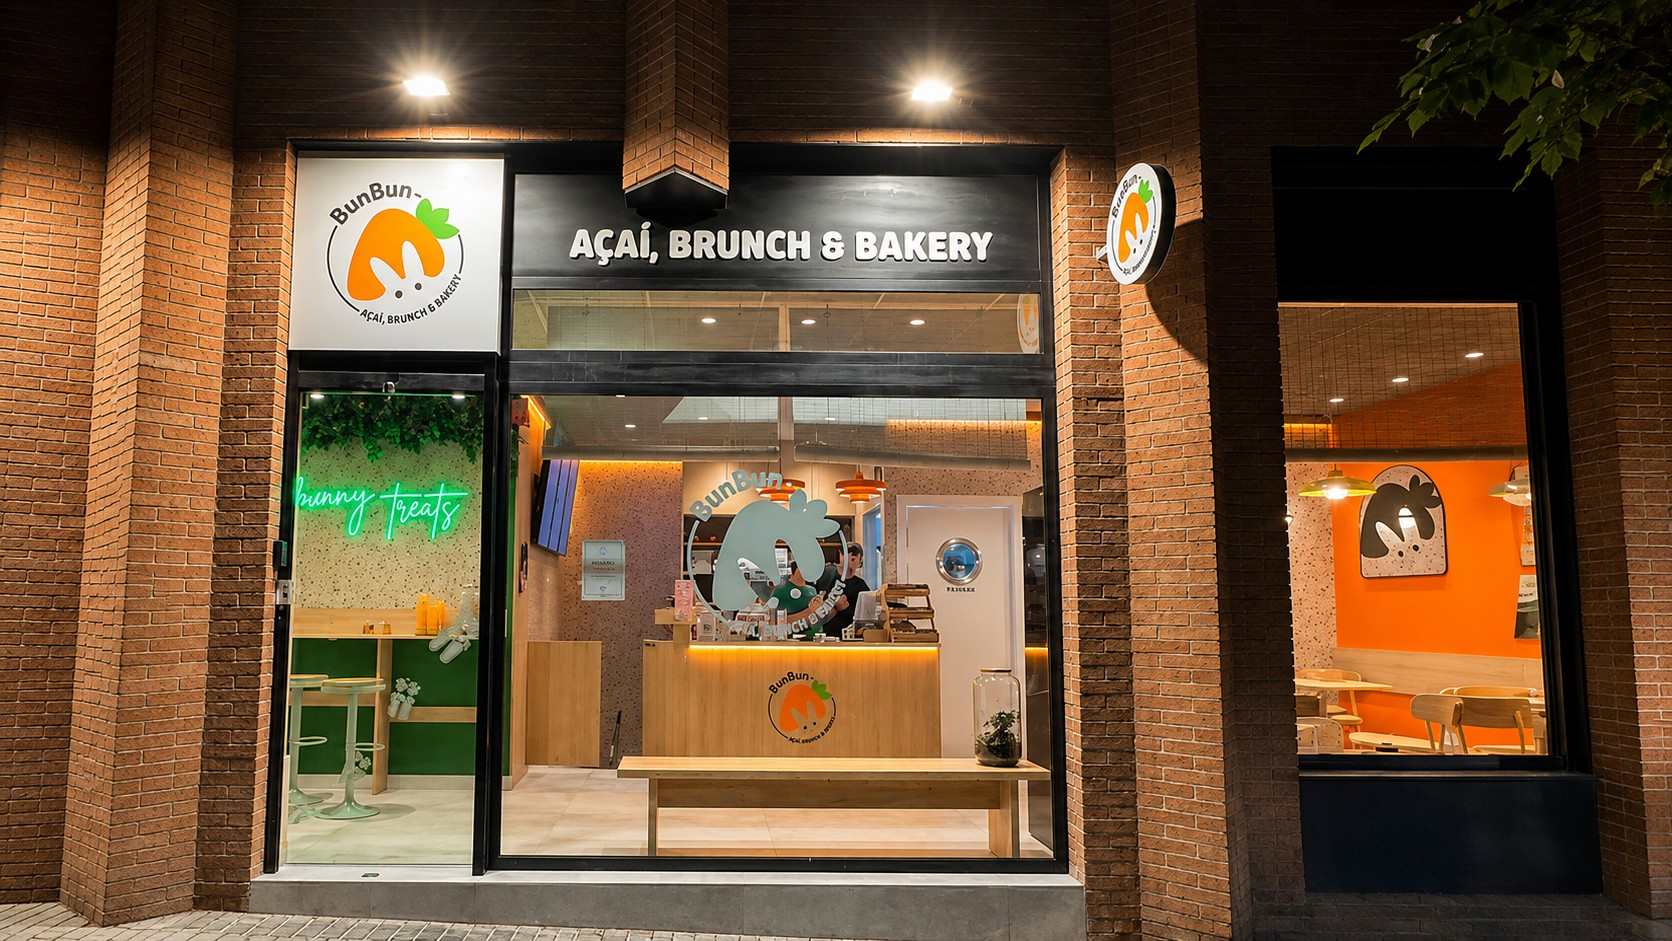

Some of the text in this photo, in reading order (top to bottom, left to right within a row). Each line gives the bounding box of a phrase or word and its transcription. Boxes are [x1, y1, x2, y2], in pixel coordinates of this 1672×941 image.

[569, 221, 993, 265] AÇAÍ, BRUNCH & BAKERY
[360, 273, 462, 325] AÇAÍ, BRUNCH & BAKERY
[295, 476, 469, 540] bunny treats
